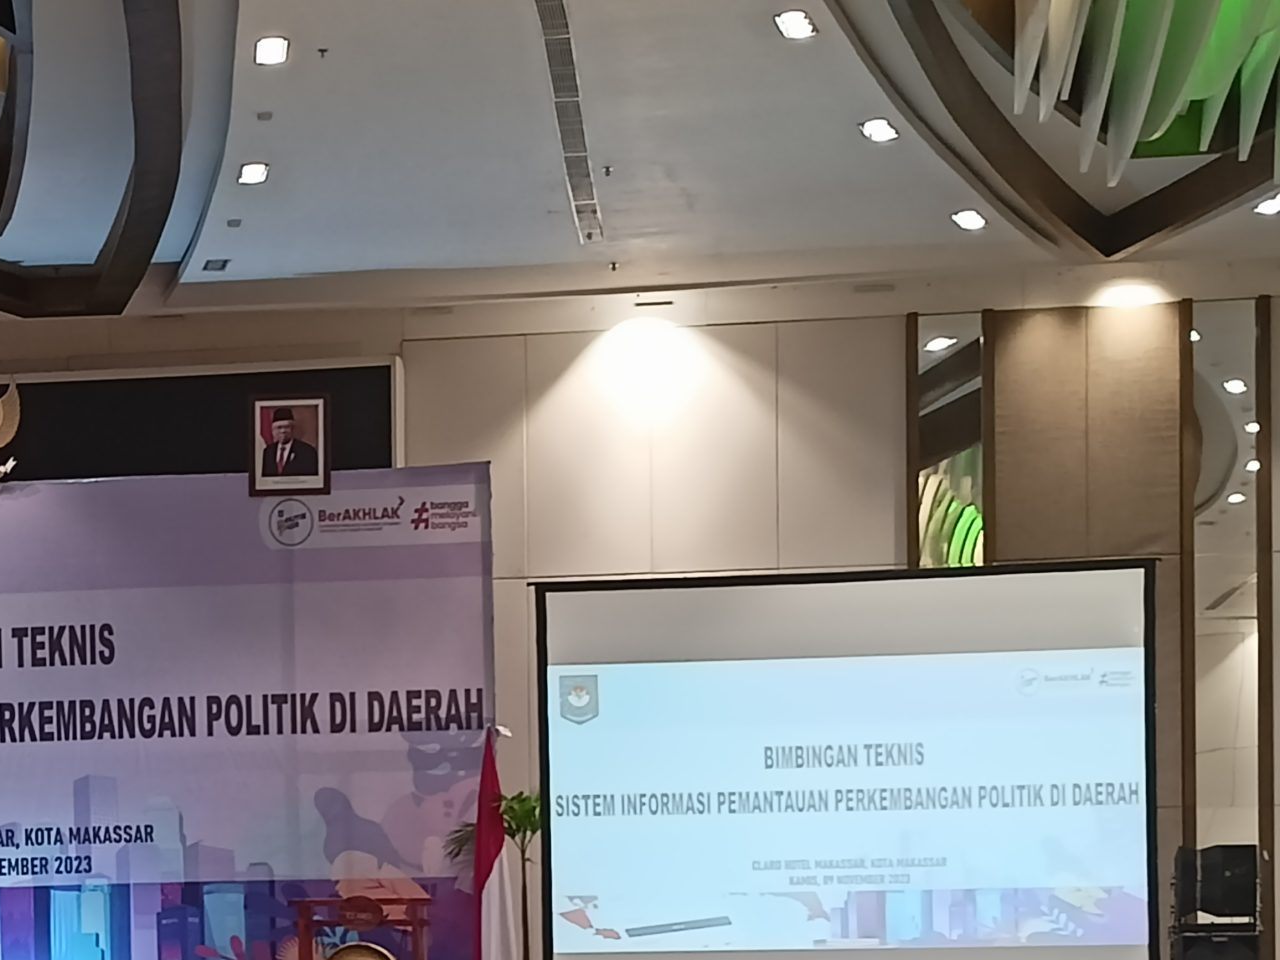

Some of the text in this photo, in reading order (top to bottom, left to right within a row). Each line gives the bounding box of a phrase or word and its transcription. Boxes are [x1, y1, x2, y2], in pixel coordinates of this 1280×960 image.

[318, 506, 401, 522] BerAKHLAK
[430, 500, 469, 511] bangga
[11, 623, 116, 668] TEKNIS
[206, 692, 320, 737] POLITIK
[329, 690, 356, 734] DI
[367, 687, 484, 733] DAERAH
[764, 742, 925, 769] BIMBINGAN TEKNIS
[555, 781, 1140, 817] SISTEM INFORMASI PEMANTAUAN PERKEMBANGAN POLITIK DI DAERAH
[24, 827, 64, 847] KOTA
[69, 824, 154, 845] MAKASSAR
[54, 855, 93, 874] 2023
